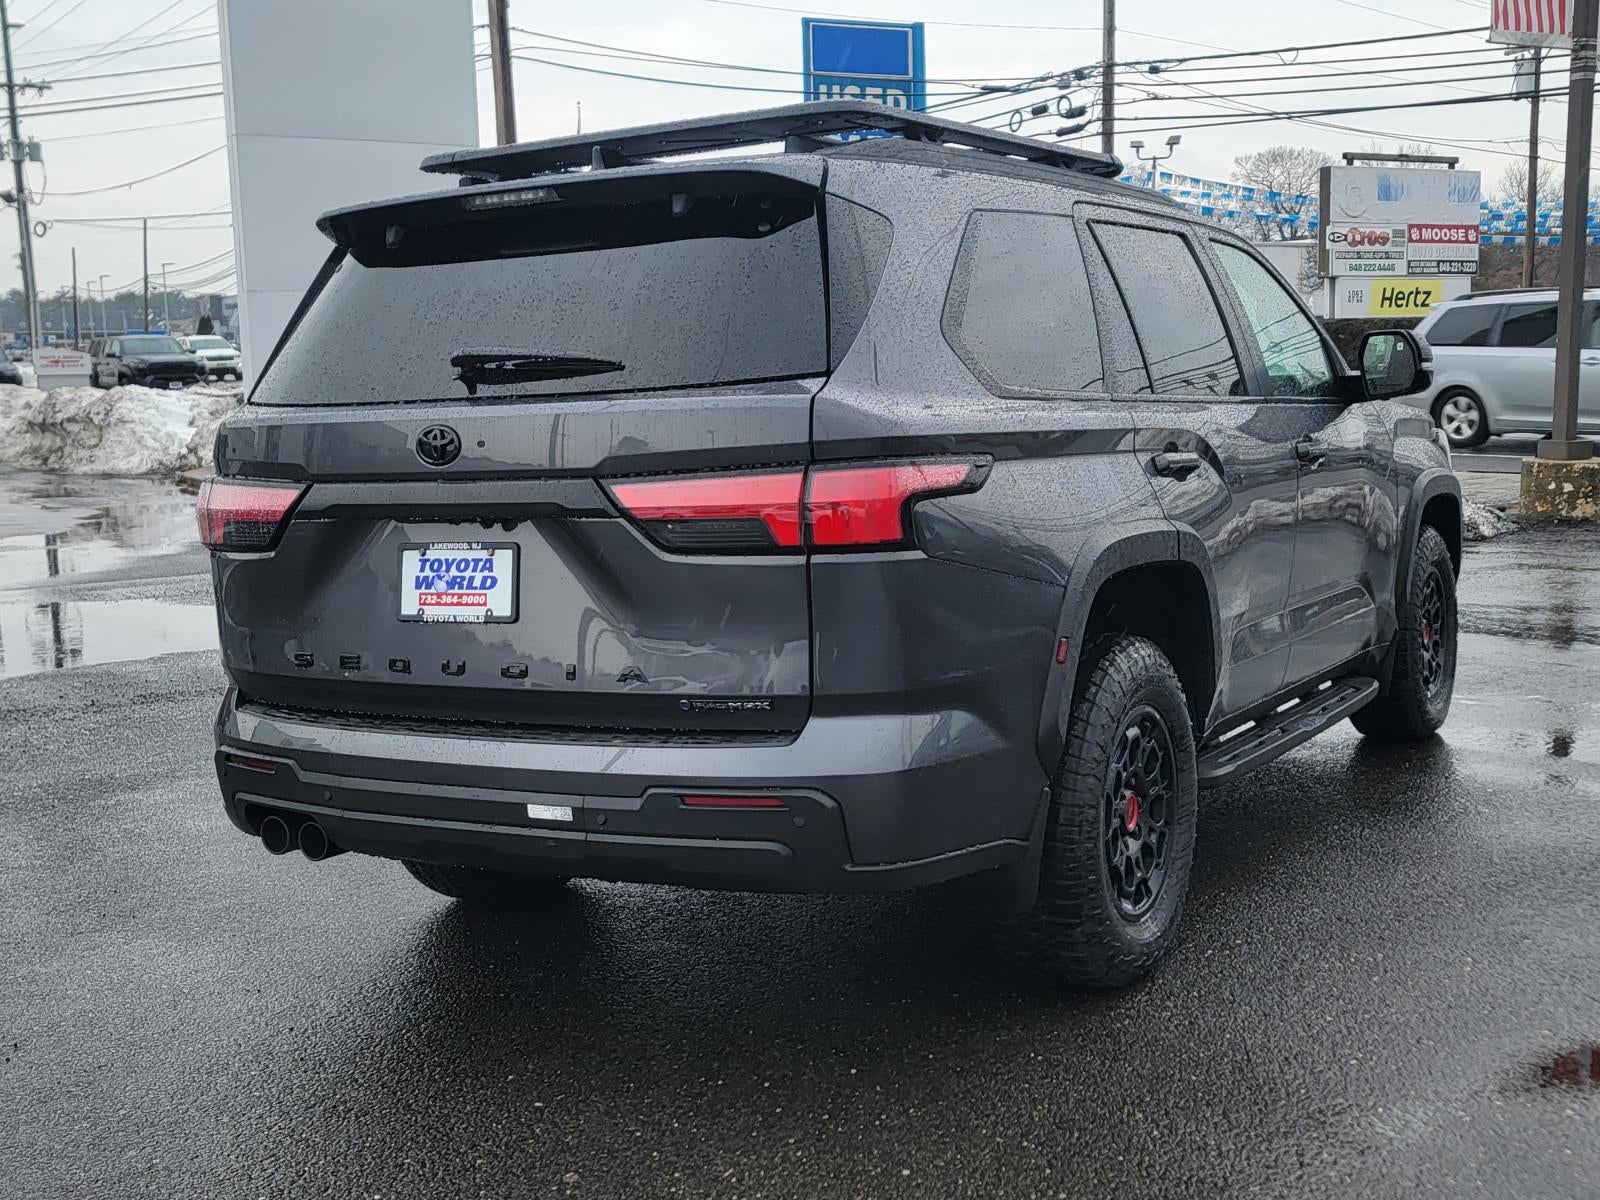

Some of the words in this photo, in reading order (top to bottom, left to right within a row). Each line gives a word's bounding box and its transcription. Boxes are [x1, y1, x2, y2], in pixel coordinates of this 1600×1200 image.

[1421, 228, 1466, 241] MOOSE
[1439, 262, 1477, 273] 848-221-3220
[1348, 289, 1363, 298] 1093
[1380, 287, 1432, 309] Hertz
[418, 557, 494, 573] TOYOTA
[414, 573, 498, 592] WORLD
[420, 594, 486, 604] 732-364-9000
[422, 614, 455, 623] TOYOTA
[456, 615, 485, 623] WORLD
[293, 651, 651, 685] SEQUOIA
